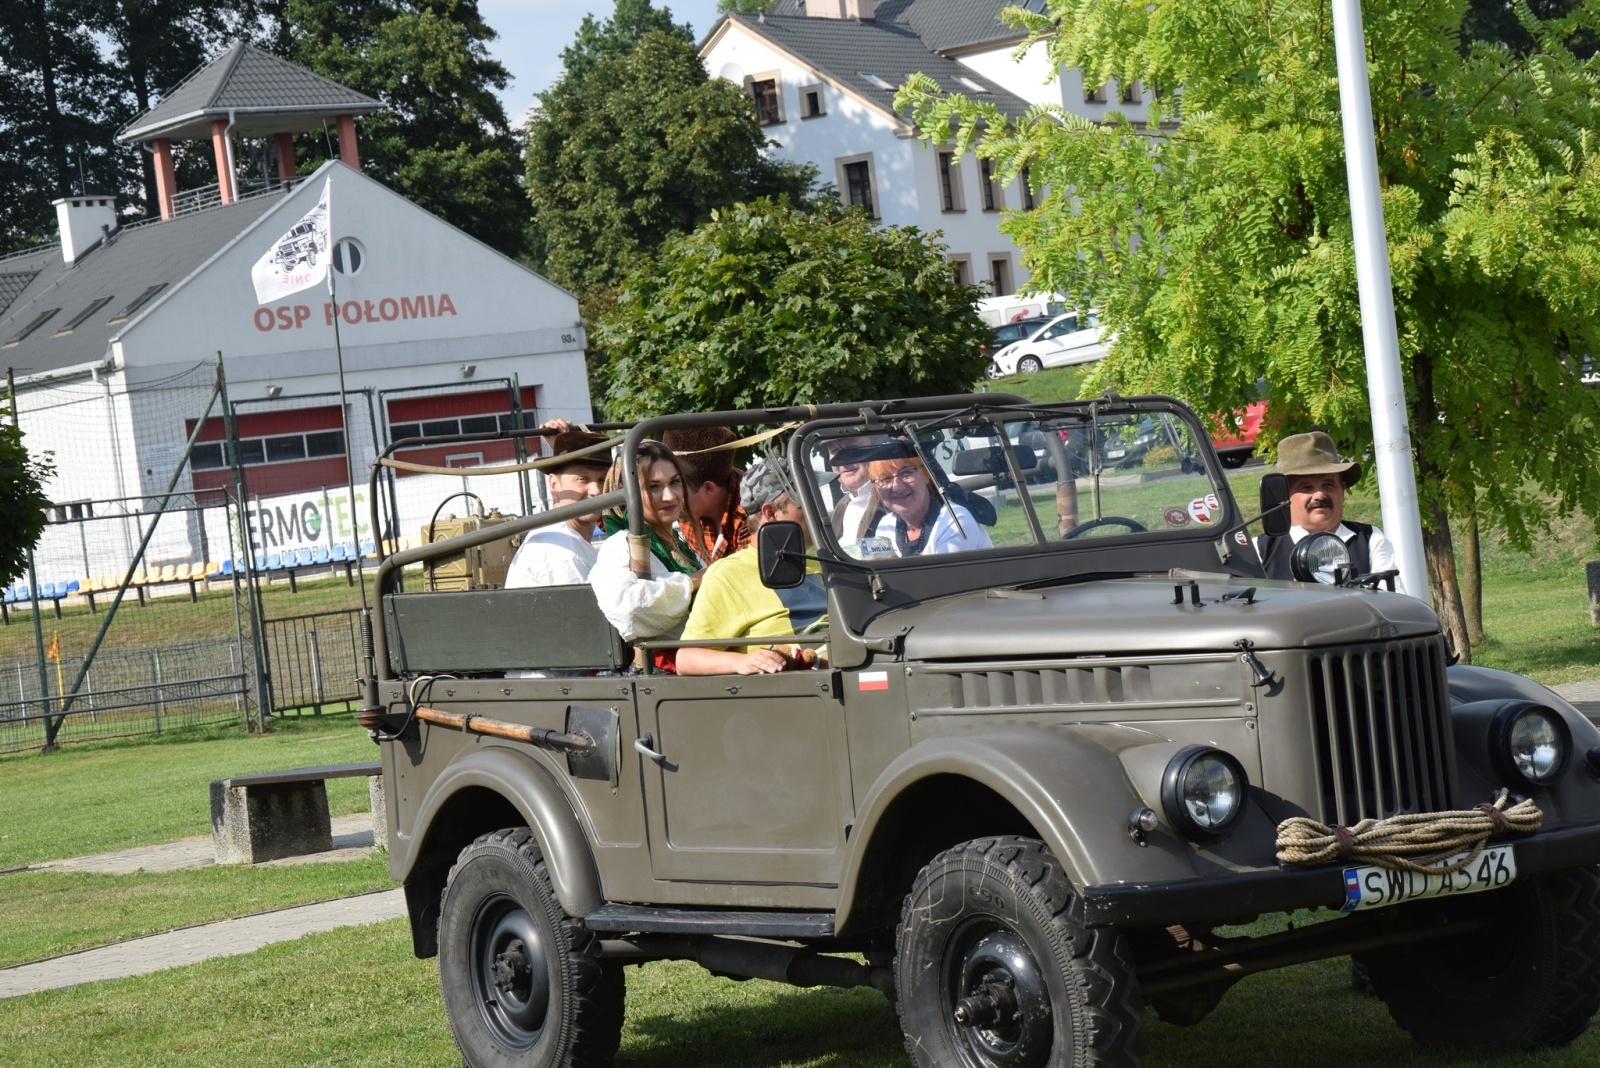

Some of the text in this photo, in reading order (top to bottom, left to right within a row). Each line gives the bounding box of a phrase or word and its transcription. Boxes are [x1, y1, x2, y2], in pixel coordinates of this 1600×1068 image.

[254, 293, 458, 332] OSP POŁOMIA
[1365, 868, 1428, 906] SWD
